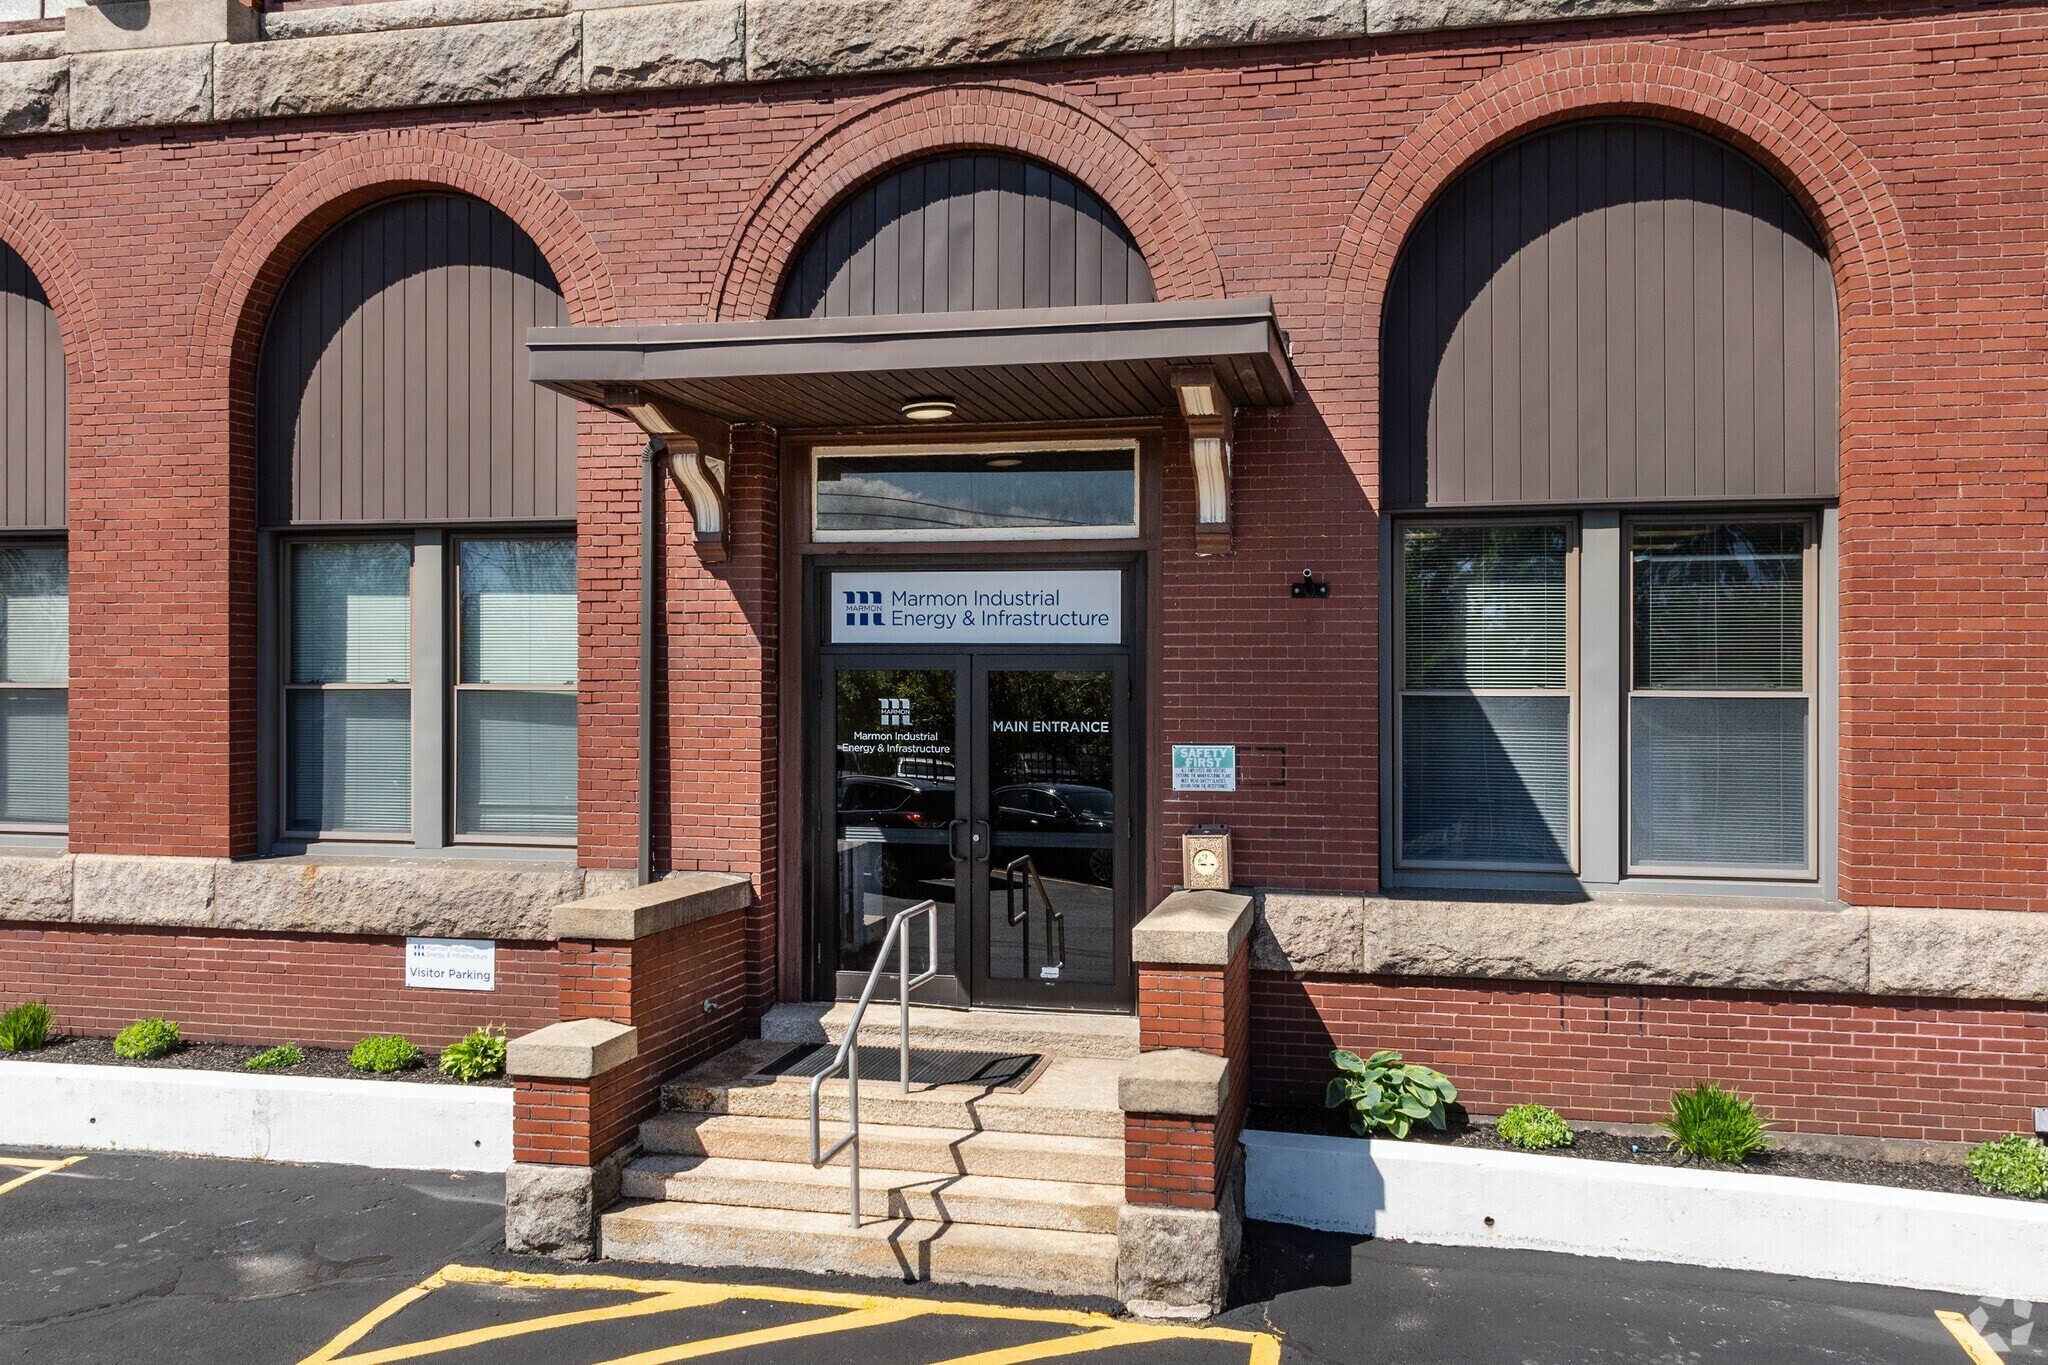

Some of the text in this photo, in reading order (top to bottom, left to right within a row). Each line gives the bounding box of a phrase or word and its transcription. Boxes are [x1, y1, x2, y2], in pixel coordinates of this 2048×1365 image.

[892, 589, 1060, 606] Marmon Industrial
[892, 609, 1110, 630] Energy & Infrastructure
[992, 720, 1110, 733] MAIN ENTRANCE
[853, 731, 938, 741] Marmon Industrial
[842, 743, 951, 754] Energy & Infrastructure
[1180, 748, 1227, 758] SAFETY
[1185, 757, 1222, 768] FIRST
[410, 967, 491, 983] Visitor Parking
